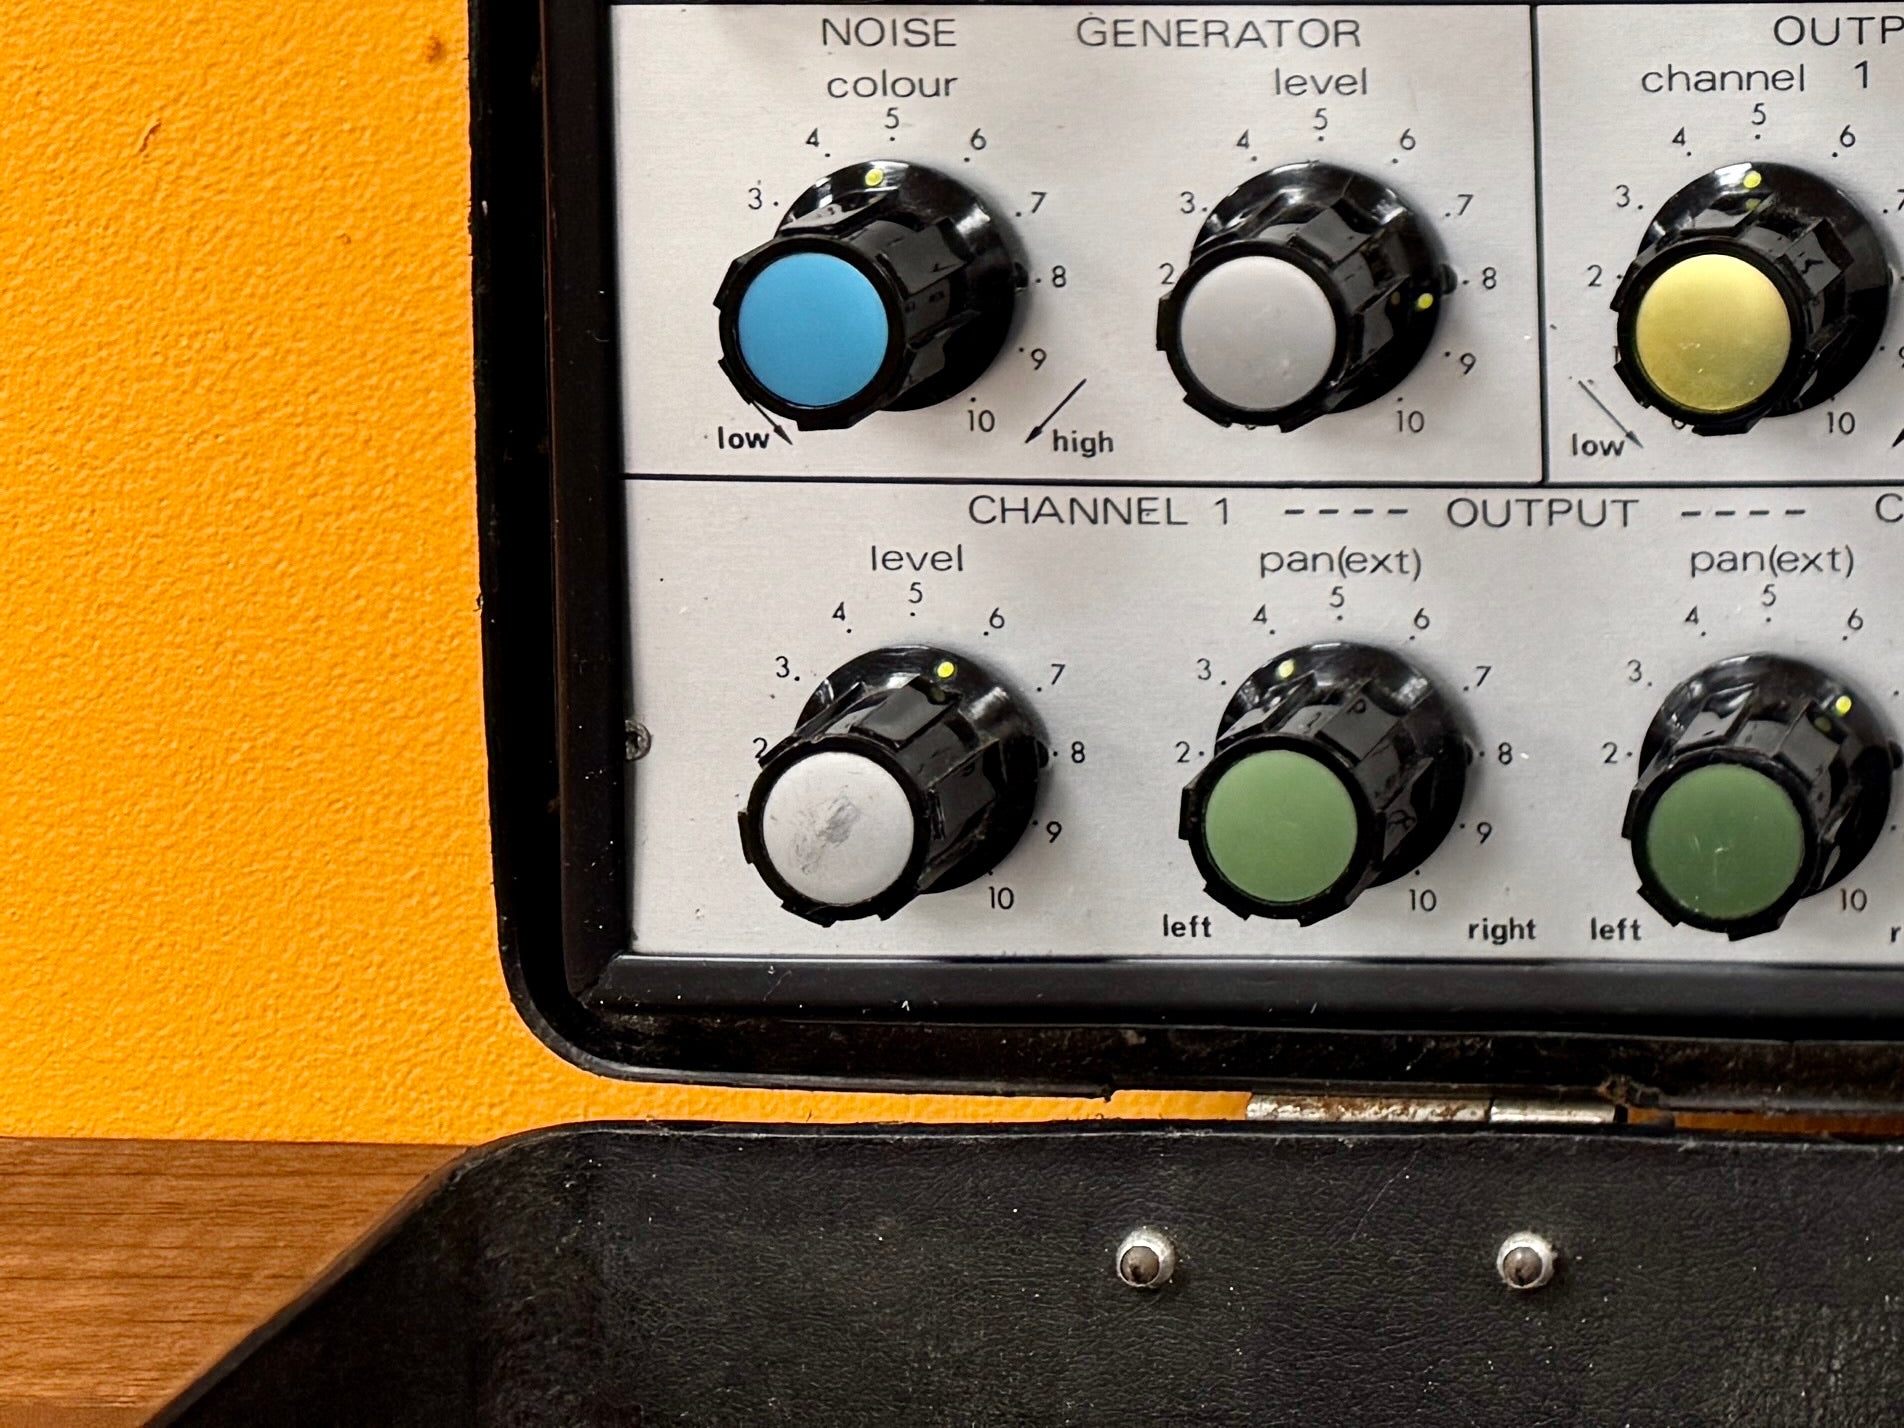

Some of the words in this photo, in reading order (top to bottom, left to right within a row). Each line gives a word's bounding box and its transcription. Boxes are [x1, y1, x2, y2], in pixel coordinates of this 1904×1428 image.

[821, 16, 957, 48] NOISE
[1075, 11, 1361, 49] GENERATOR
[826, 68, 959, 99] colour
[1274, 66, 1368, 97] level
[1641, 63, 1805, 94] channel
[1853, 59, 1868, 89] 1
[1571, 432, 1626, 457] low
[968, 494, 1189, 526] CHANNEL
[1214, 497, 1228, 526] 1
[1446, 497, 1640, 529] OUTPUT
[871, 543, 964, 572] level
[1259, 545, 1422, 583] pan(ext)
[1162, 913, 1212, 938] left
[1468, 916, 1537, 946] right
